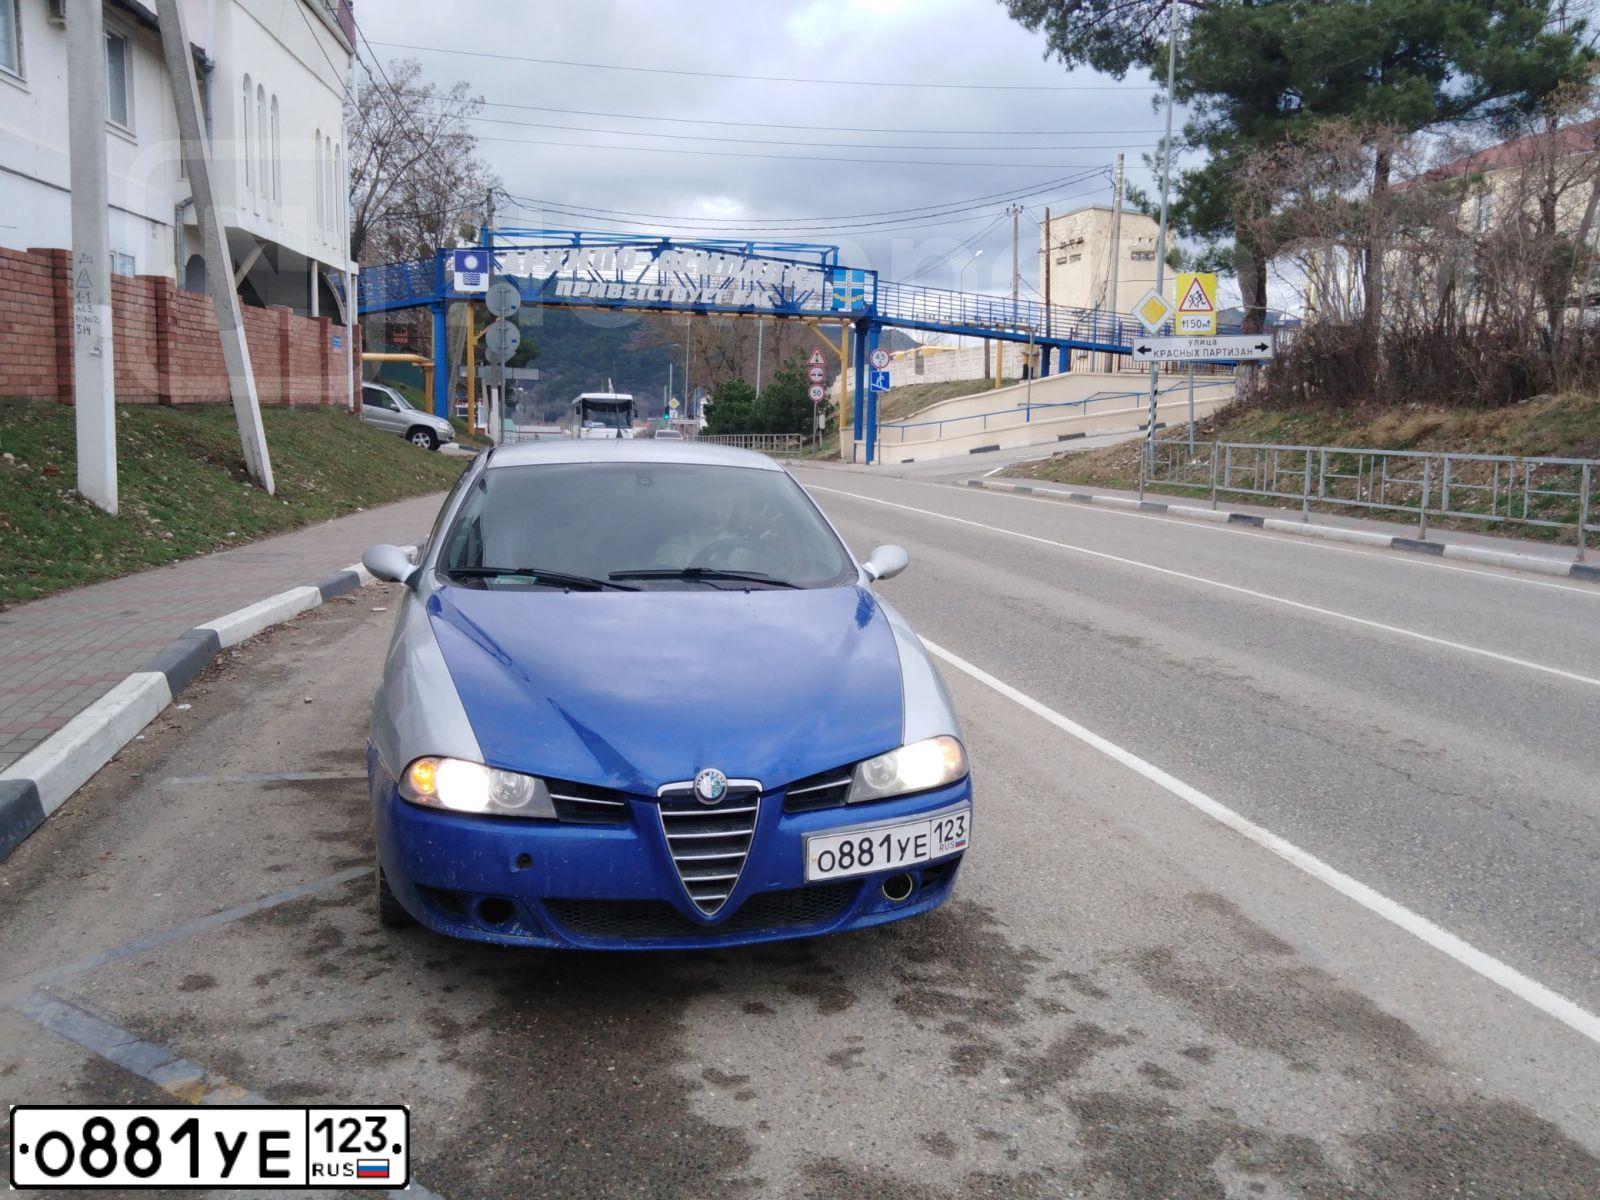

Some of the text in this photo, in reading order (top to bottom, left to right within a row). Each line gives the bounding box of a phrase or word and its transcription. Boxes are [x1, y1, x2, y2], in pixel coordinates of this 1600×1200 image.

[555, 280, 728, 304] ПРИВЕТСТВУЕТ
[1188, 338, 1218, 347] улица
[1153, 348, 1253, 359] КРАСНЫХ ПАРТИЗАН
[933, 815, 965, 844] 123
[938, 842, 955, 852] RUS
